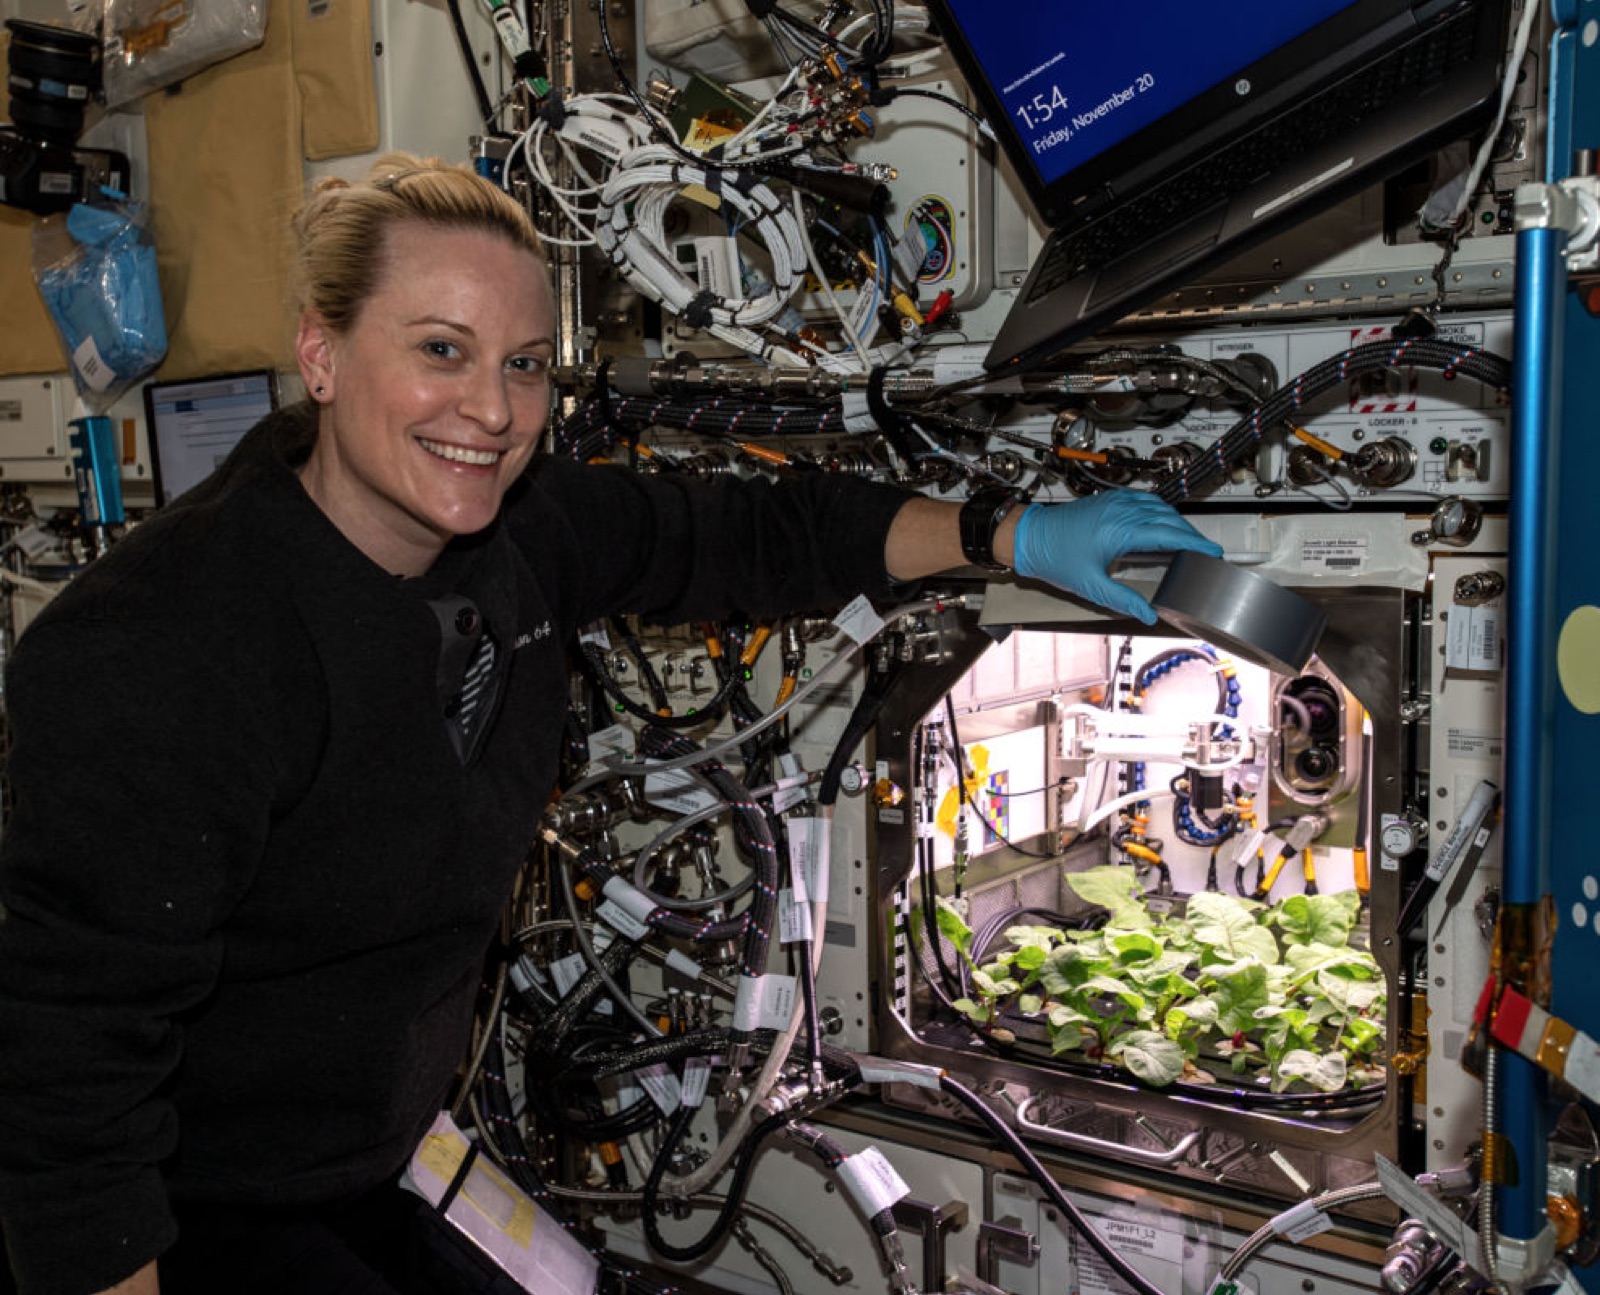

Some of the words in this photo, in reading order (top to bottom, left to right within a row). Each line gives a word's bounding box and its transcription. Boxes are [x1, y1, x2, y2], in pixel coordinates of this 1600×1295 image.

[1017, 85, 1068, 129] 1:54
[1032, 126, 1074, 154] Friday,
[1071, 84, 1136, 130] November
[1134, 73, 1154, 93] 20
[1368, 418, 1405, 426] LOCKER
